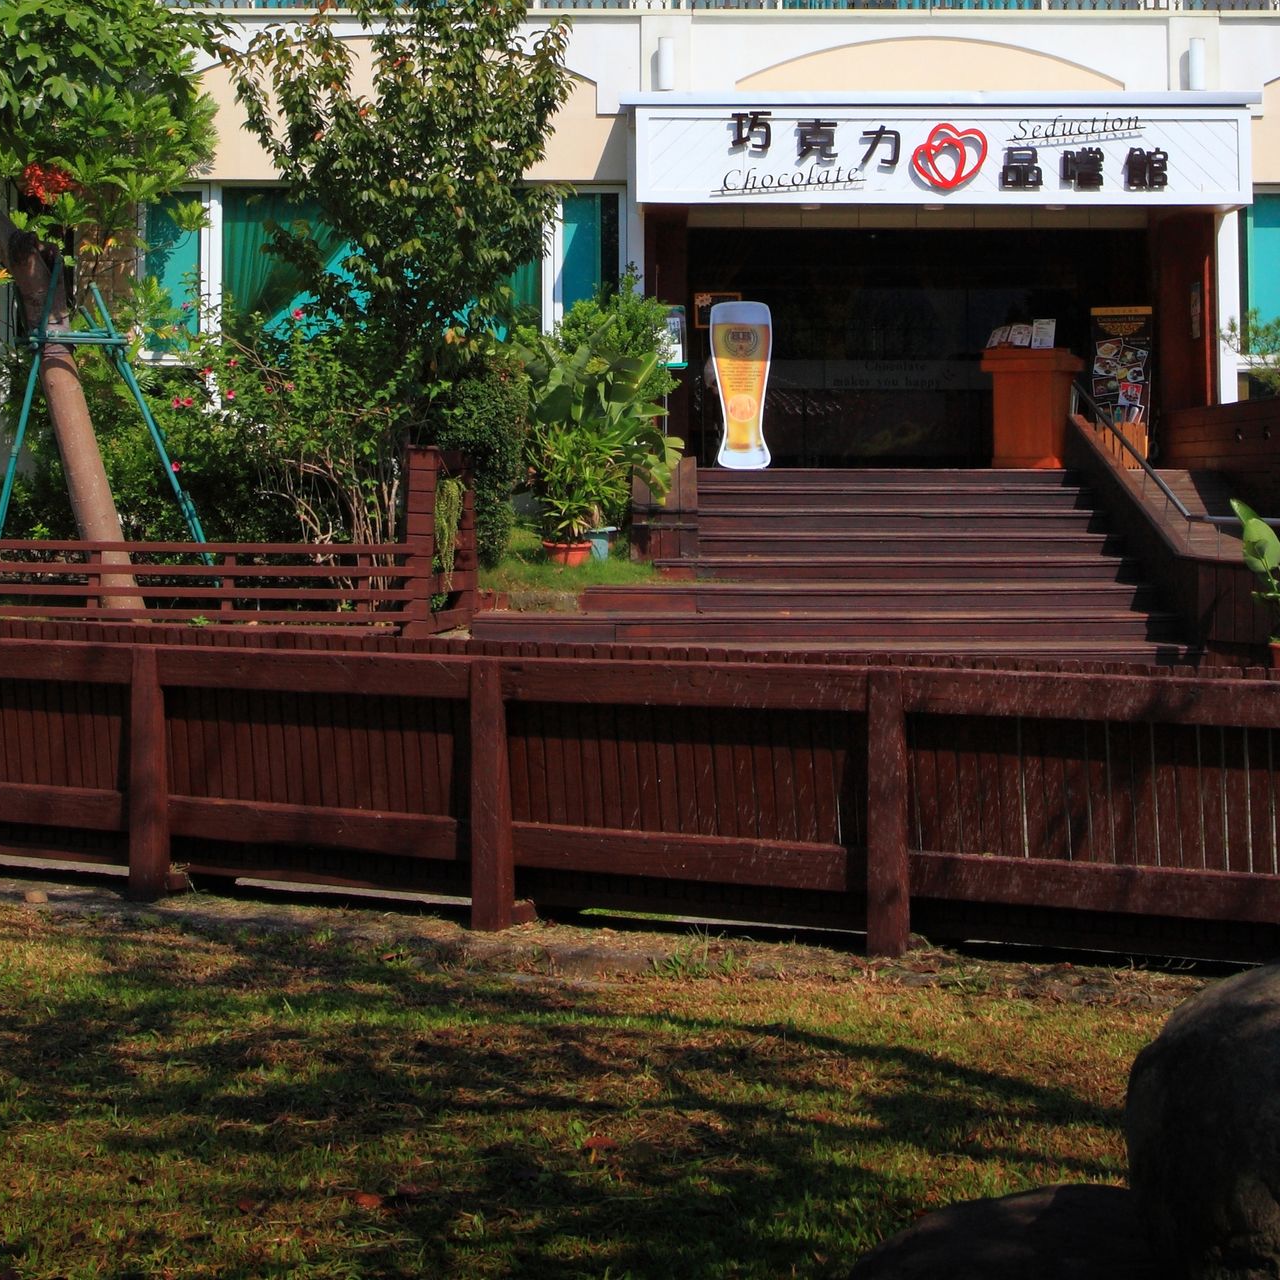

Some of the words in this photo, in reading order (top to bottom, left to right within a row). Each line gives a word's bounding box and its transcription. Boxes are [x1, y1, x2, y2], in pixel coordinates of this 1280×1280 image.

[732, 111, 901, 165] 巧克力
[1013, 112, 1141, 140] Seduction
[723, 162, 859, 191] Chocolate
